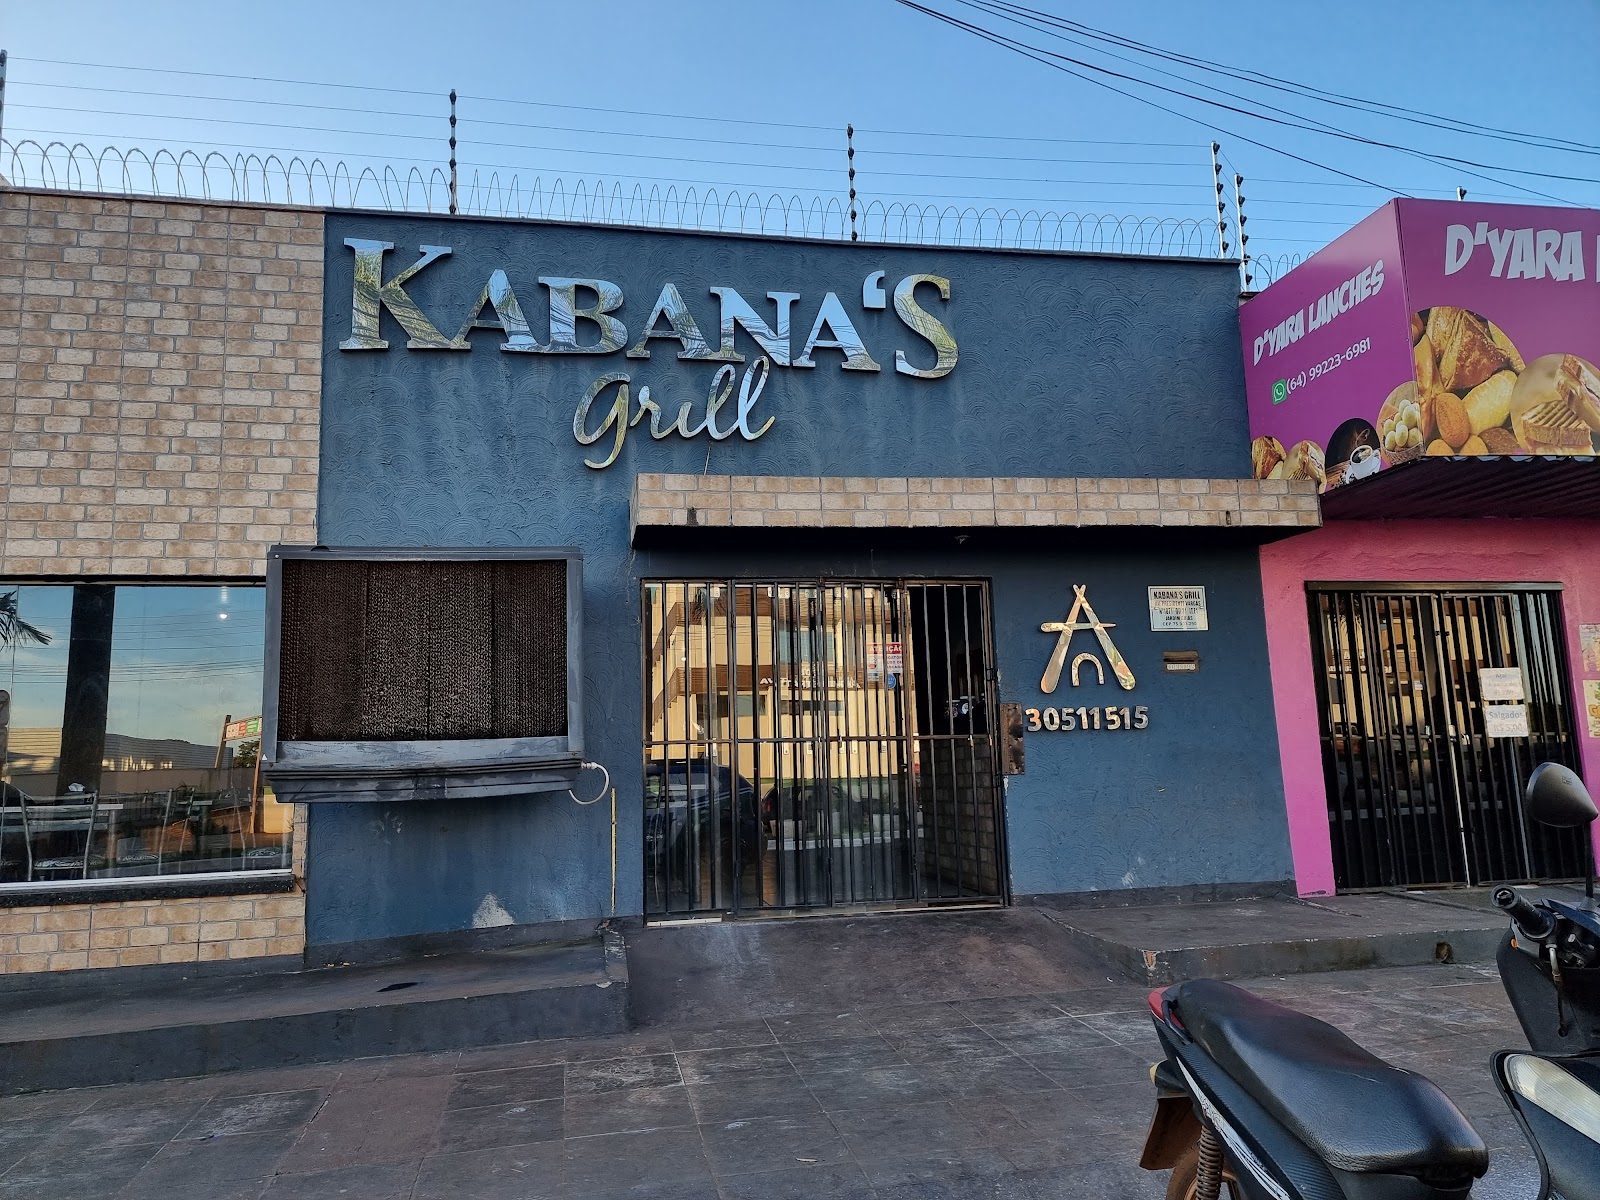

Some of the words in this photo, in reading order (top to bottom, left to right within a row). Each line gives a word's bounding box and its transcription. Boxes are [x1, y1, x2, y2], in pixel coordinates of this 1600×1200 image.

[1444, 222, 1586, 282] D'YARA
[338, 237, 959, 379] KABANA'S
[1253, 309, 1305, 366] D'YARA
[1308, 259, 1386, 333] LANCHES
[1286, 371, 1307, 394] (64)
[1309, 337, 1371, 381] 99223-6981
[572, 355, 776, 469] grill
[1184, 591, 1201, 599] GRILL
[1024, 705, 1149, 732] 30511515
[1488, 711, 1523, 720] Salgados
